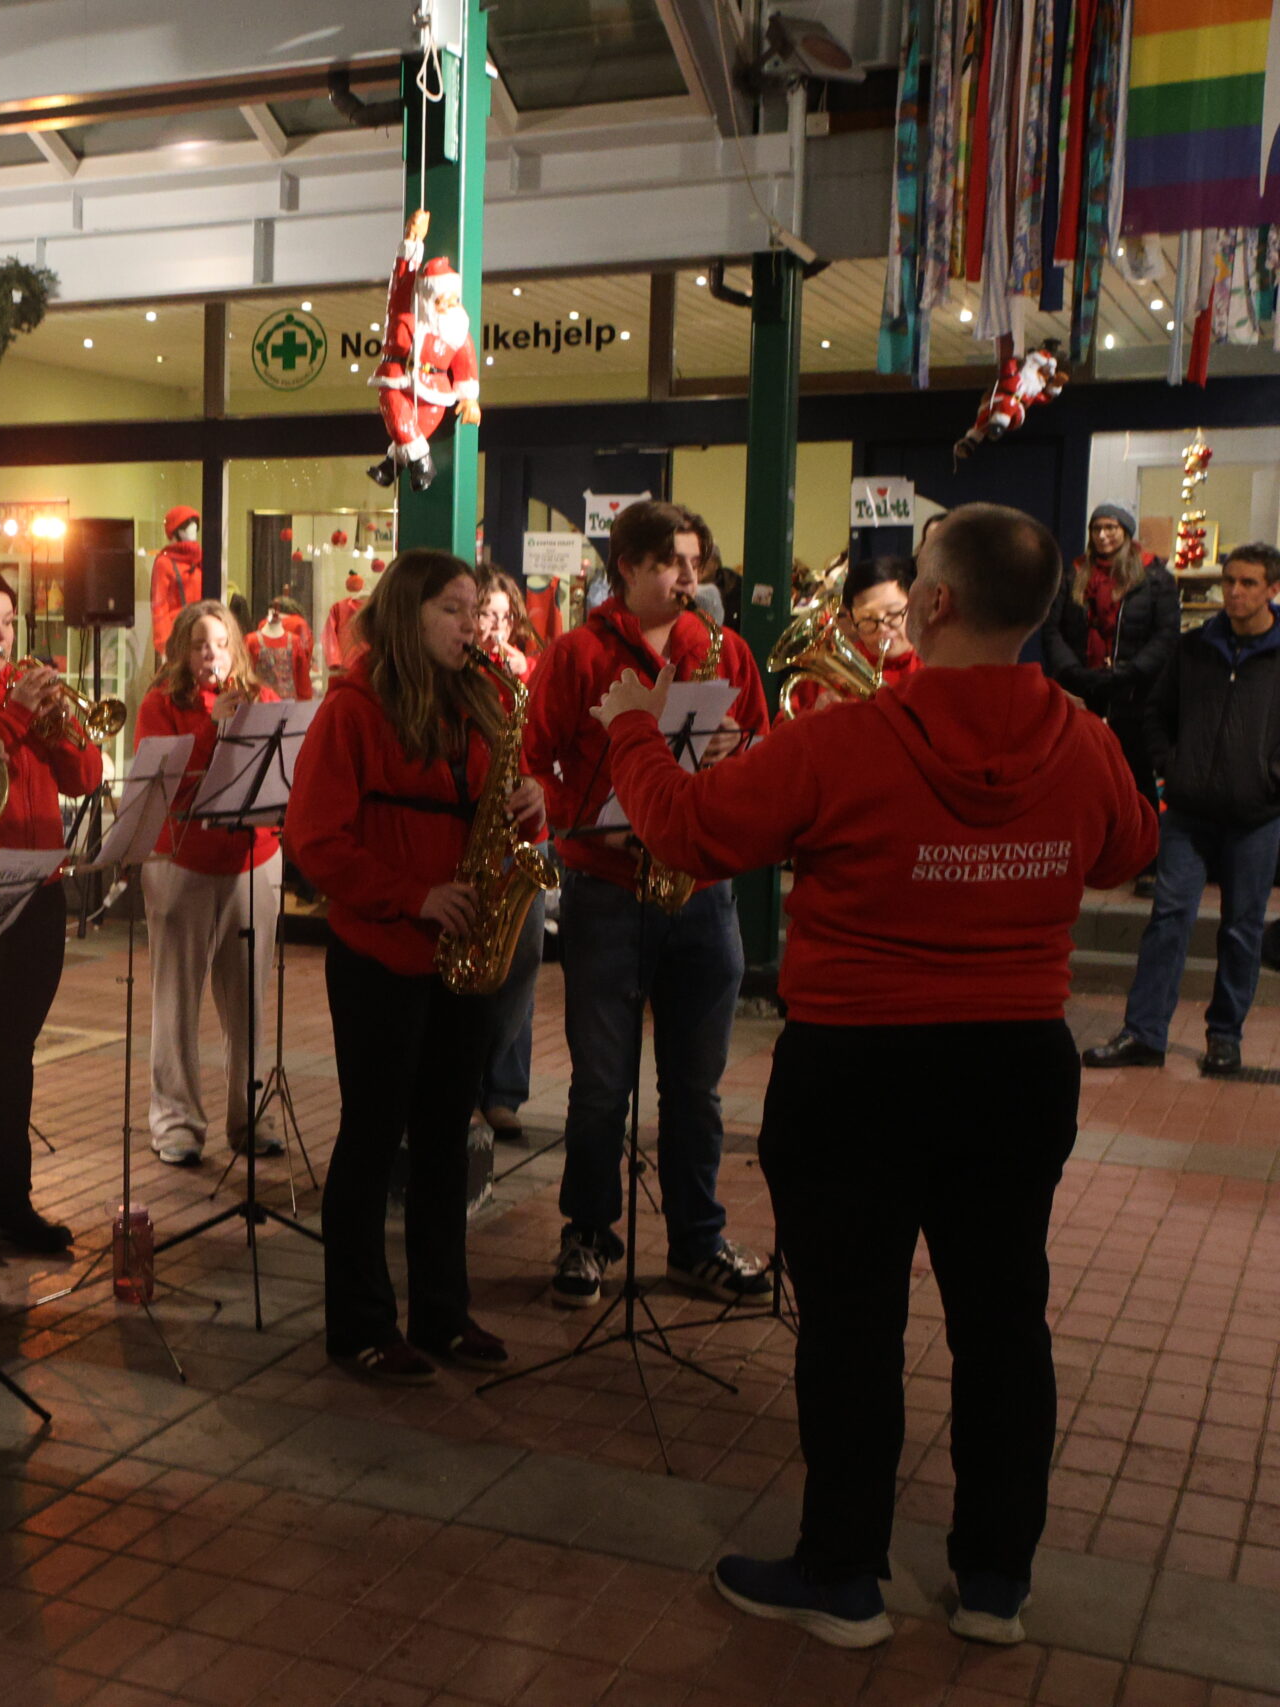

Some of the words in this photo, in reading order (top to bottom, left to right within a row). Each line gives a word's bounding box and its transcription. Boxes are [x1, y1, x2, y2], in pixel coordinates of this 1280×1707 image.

[483, 318, 616, 354] lkehjelp
[917, 840, 1072, 862] KONGSVINGER
[911, 860, 1069, 882] SKOLEKORPS
